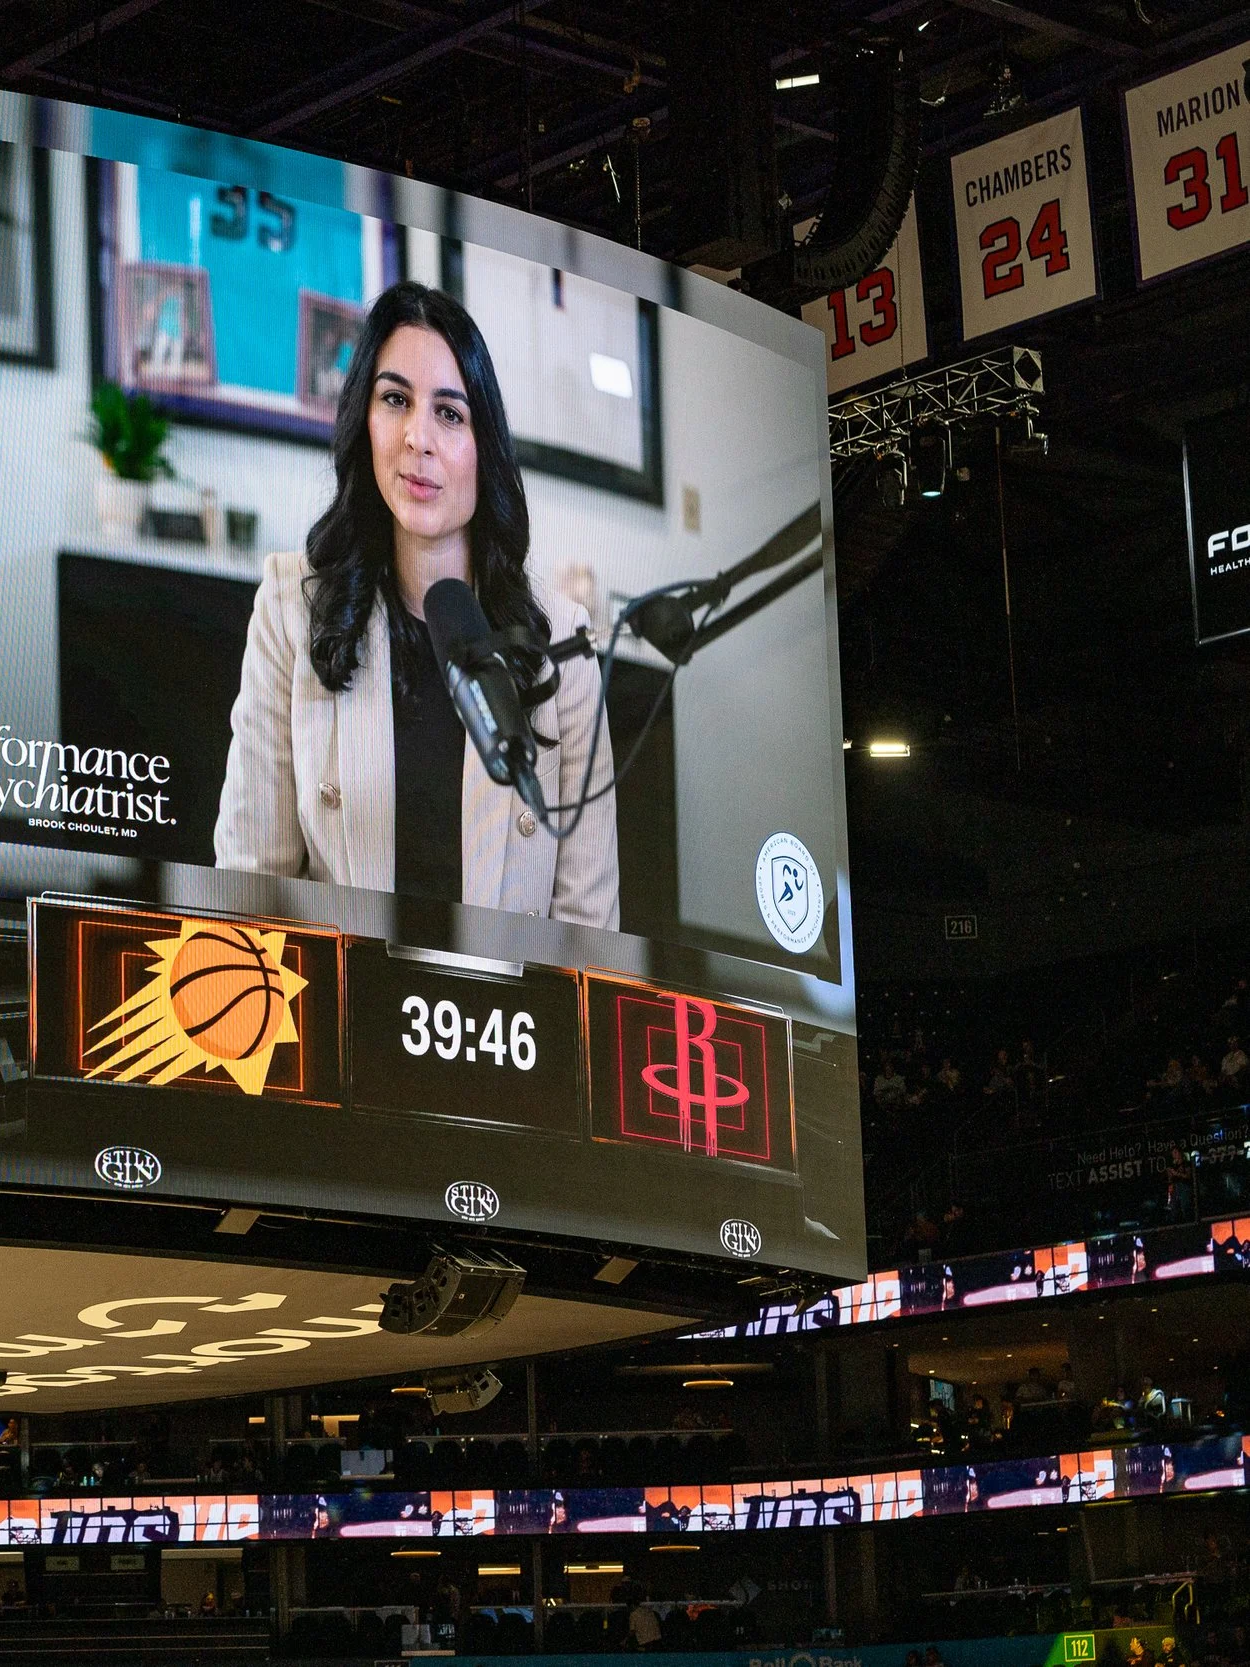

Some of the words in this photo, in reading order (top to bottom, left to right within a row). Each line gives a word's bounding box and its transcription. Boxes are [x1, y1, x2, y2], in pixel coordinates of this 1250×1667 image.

[1157, 79, 1241, 137] MARION
[965, 144, 1073, 207] CHAMBERS
[1164, 131, 1250, 231] 31
[979, 199, 1069, 299] 24
[828, 266, 898, 360] 13
[28, 816, 66, 831] BROOK
[68, 822, 120, 837] CHOULET,
[121, 827, 138, 838] MD
[950, 920, 972, 935] 216
[400, 994, 537, 1071] 39:46
[1077, 1150, 1106, 1167] Need
[1109, 1143, 1141, 1162] Help?
[1189, 1125, 1250, 1147] Question?
[103, 1150, 155, 1168] STILL
[102, 1162, 154, 1184] GIN
[1047, 1170, 1084, 1191] TEXT
[1088, 1160, 1143, 1185] ASSIST
[1148, 1156, 1168, 1174] TO
[451, 1185, 495, 1202] STILL
[451, 1196, 493, 1217] GIN
[724, 1233, 757, 1253] GIN
[725, 1224, 758, 1240] STILL
[1071, 1639, 1088, 1657] 112
